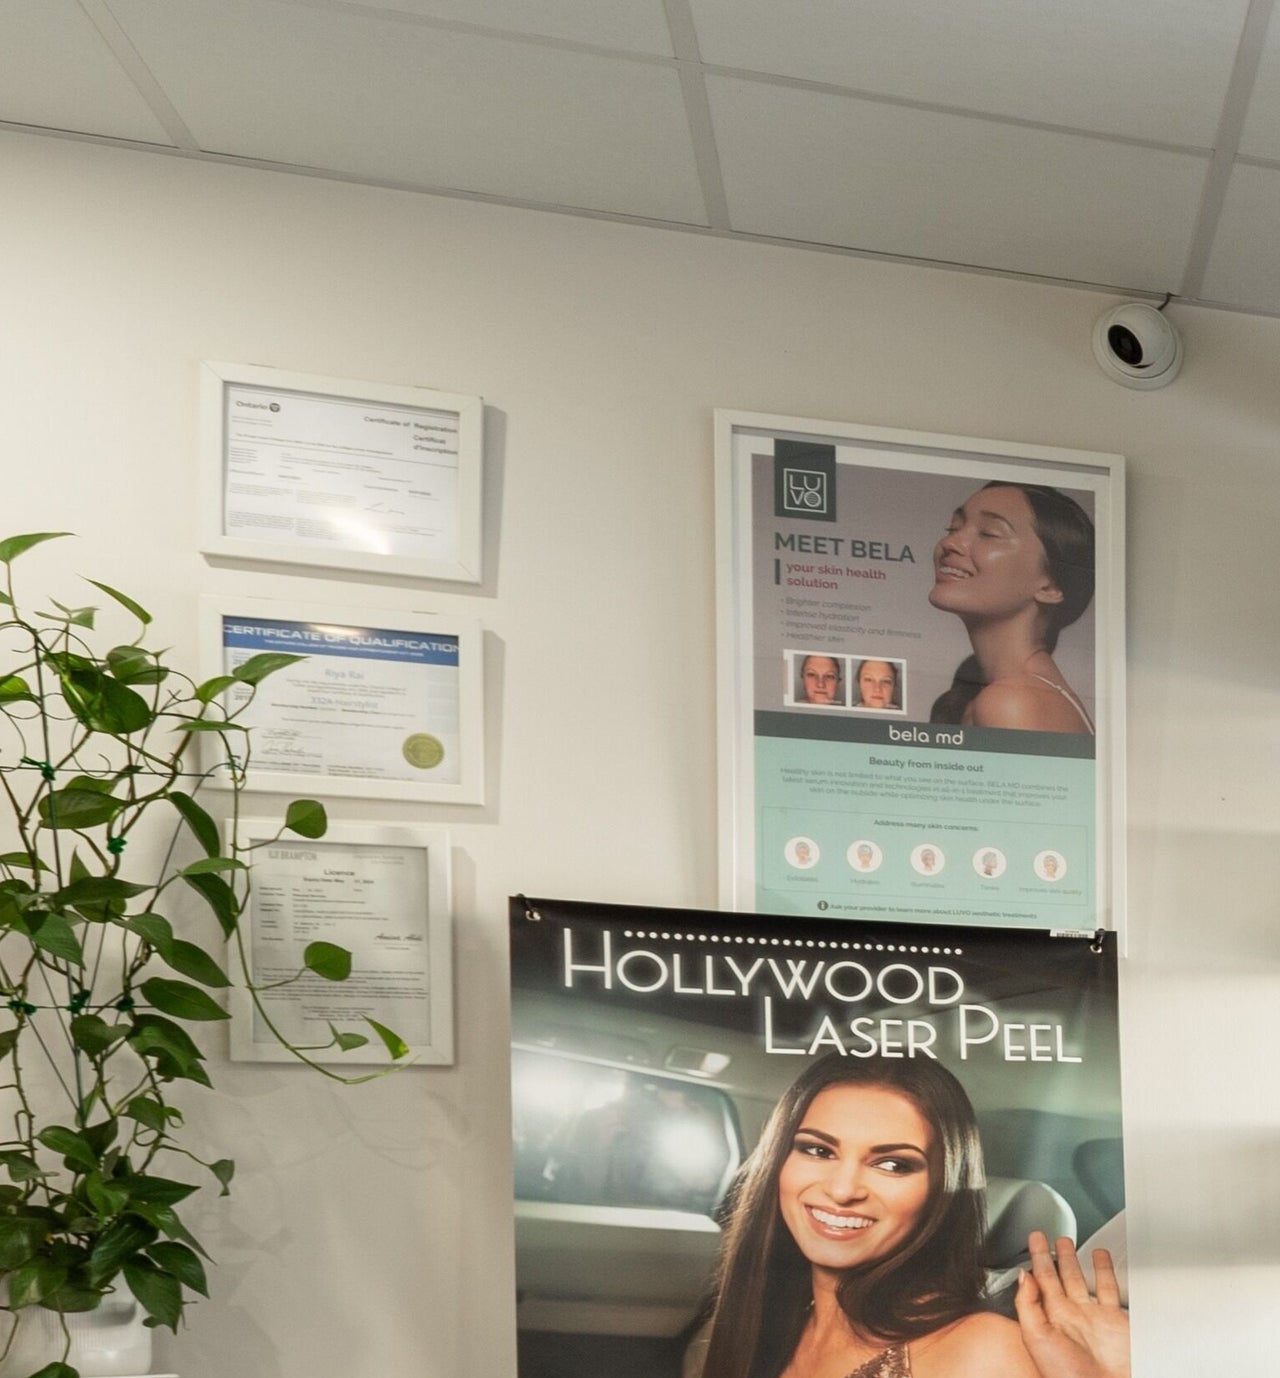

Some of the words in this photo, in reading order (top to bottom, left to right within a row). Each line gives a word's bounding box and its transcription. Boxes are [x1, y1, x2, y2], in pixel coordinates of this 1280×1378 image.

[775, 532, 844, 556] MEET
[851, 539, 916, 563] BELA
[786, 562, 815, 575] your
[818, 563, 844, 576] skin
[846, 566, 887, 580] health
[786, 576, 838, 590] solution
[785, 597, 820, 609] Brighter
[821, 599, 872, 613] complexion
[818, 610, 860, 623] hydration
[223, 623, 322, 642] CERTIFICATE
[324, 632, 346, 643] OF
[350, 635, 459, 653] QUALIFICATION
[867, 626, 886, 637] and
[889, 725, 930, 744] bela
[935, 728, 965, 746] md
[868, 756, 905, 769] Beauty
[907, 758, 932, 770] from
[934, 761, 965, 773] inside
[966, 764, 984, 773] out
[764, 996, 938, 1060] LASER
[959, 1004, 1083, 1064] PEEL
